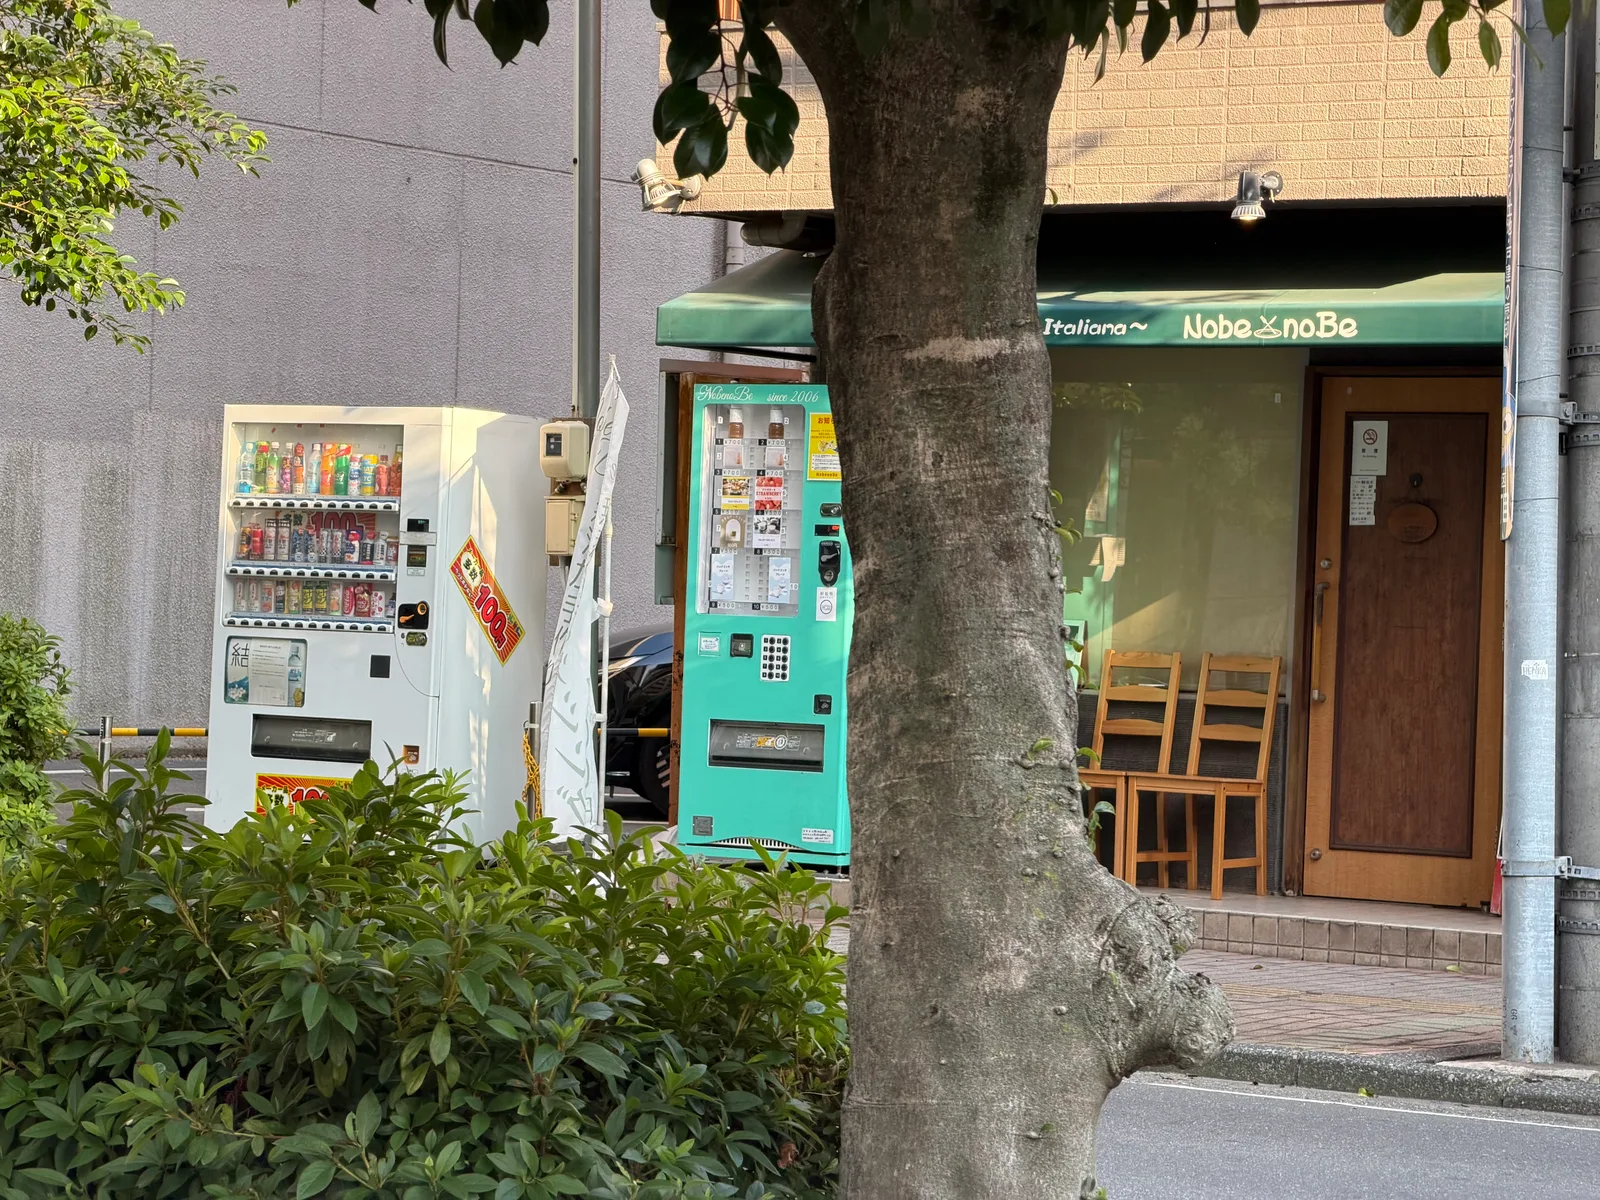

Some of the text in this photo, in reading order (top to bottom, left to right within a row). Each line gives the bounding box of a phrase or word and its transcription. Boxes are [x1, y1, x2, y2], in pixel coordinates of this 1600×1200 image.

[1182, 311, 1359, 340] Nobe noBe
[766, 391, 788, 402] since
[790, 390, 820, 403] 2006
